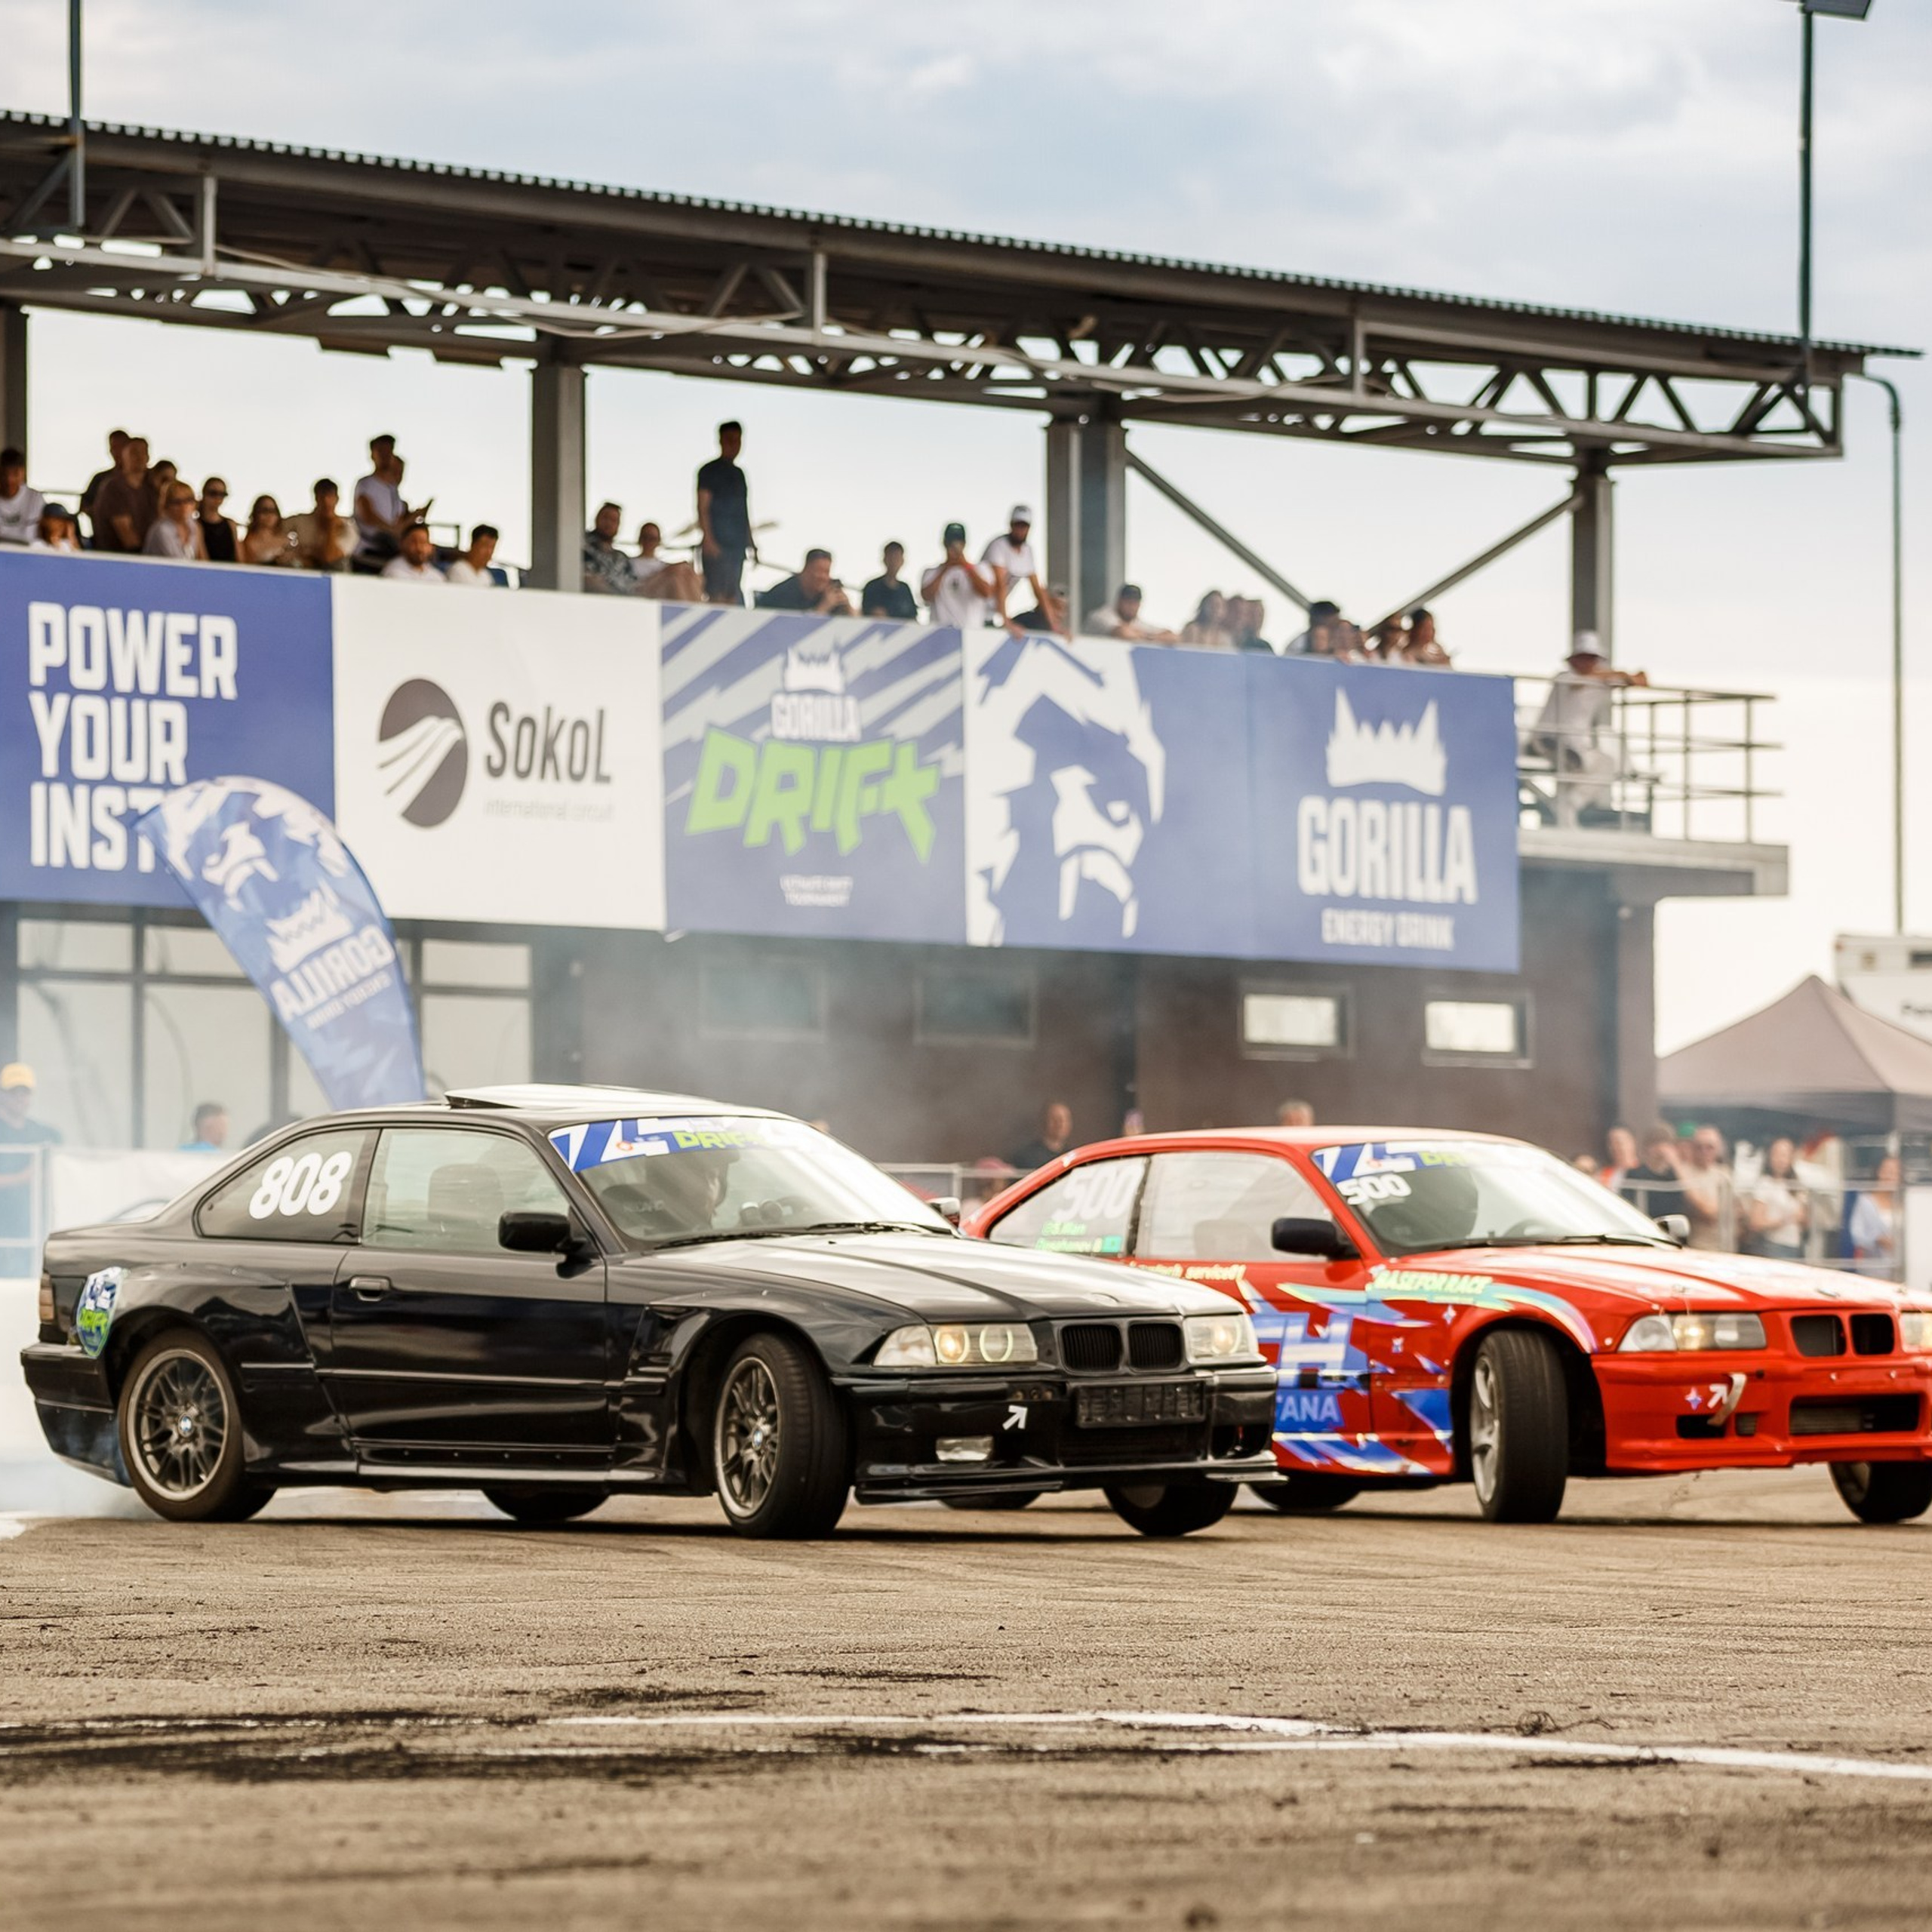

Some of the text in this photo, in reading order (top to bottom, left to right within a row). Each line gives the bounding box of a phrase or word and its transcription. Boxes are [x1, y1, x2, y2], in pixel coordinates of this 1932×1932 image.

[29, 601, 238, 700] POWER
[29, 690, 188, 786] YOUR
[771, 693, 861, 742] GORILLA
[685, 724, 940, 864] DRIFT
[1297, 794, 1478, 905] GORILLA
[1321, 907, 1455, 952] ENERGY DRINK
[248, 1151, 353, 1220] 808
[1051, 1164, 1145, 1221] 500
[1336, 1174, 1412, 1206] 500
